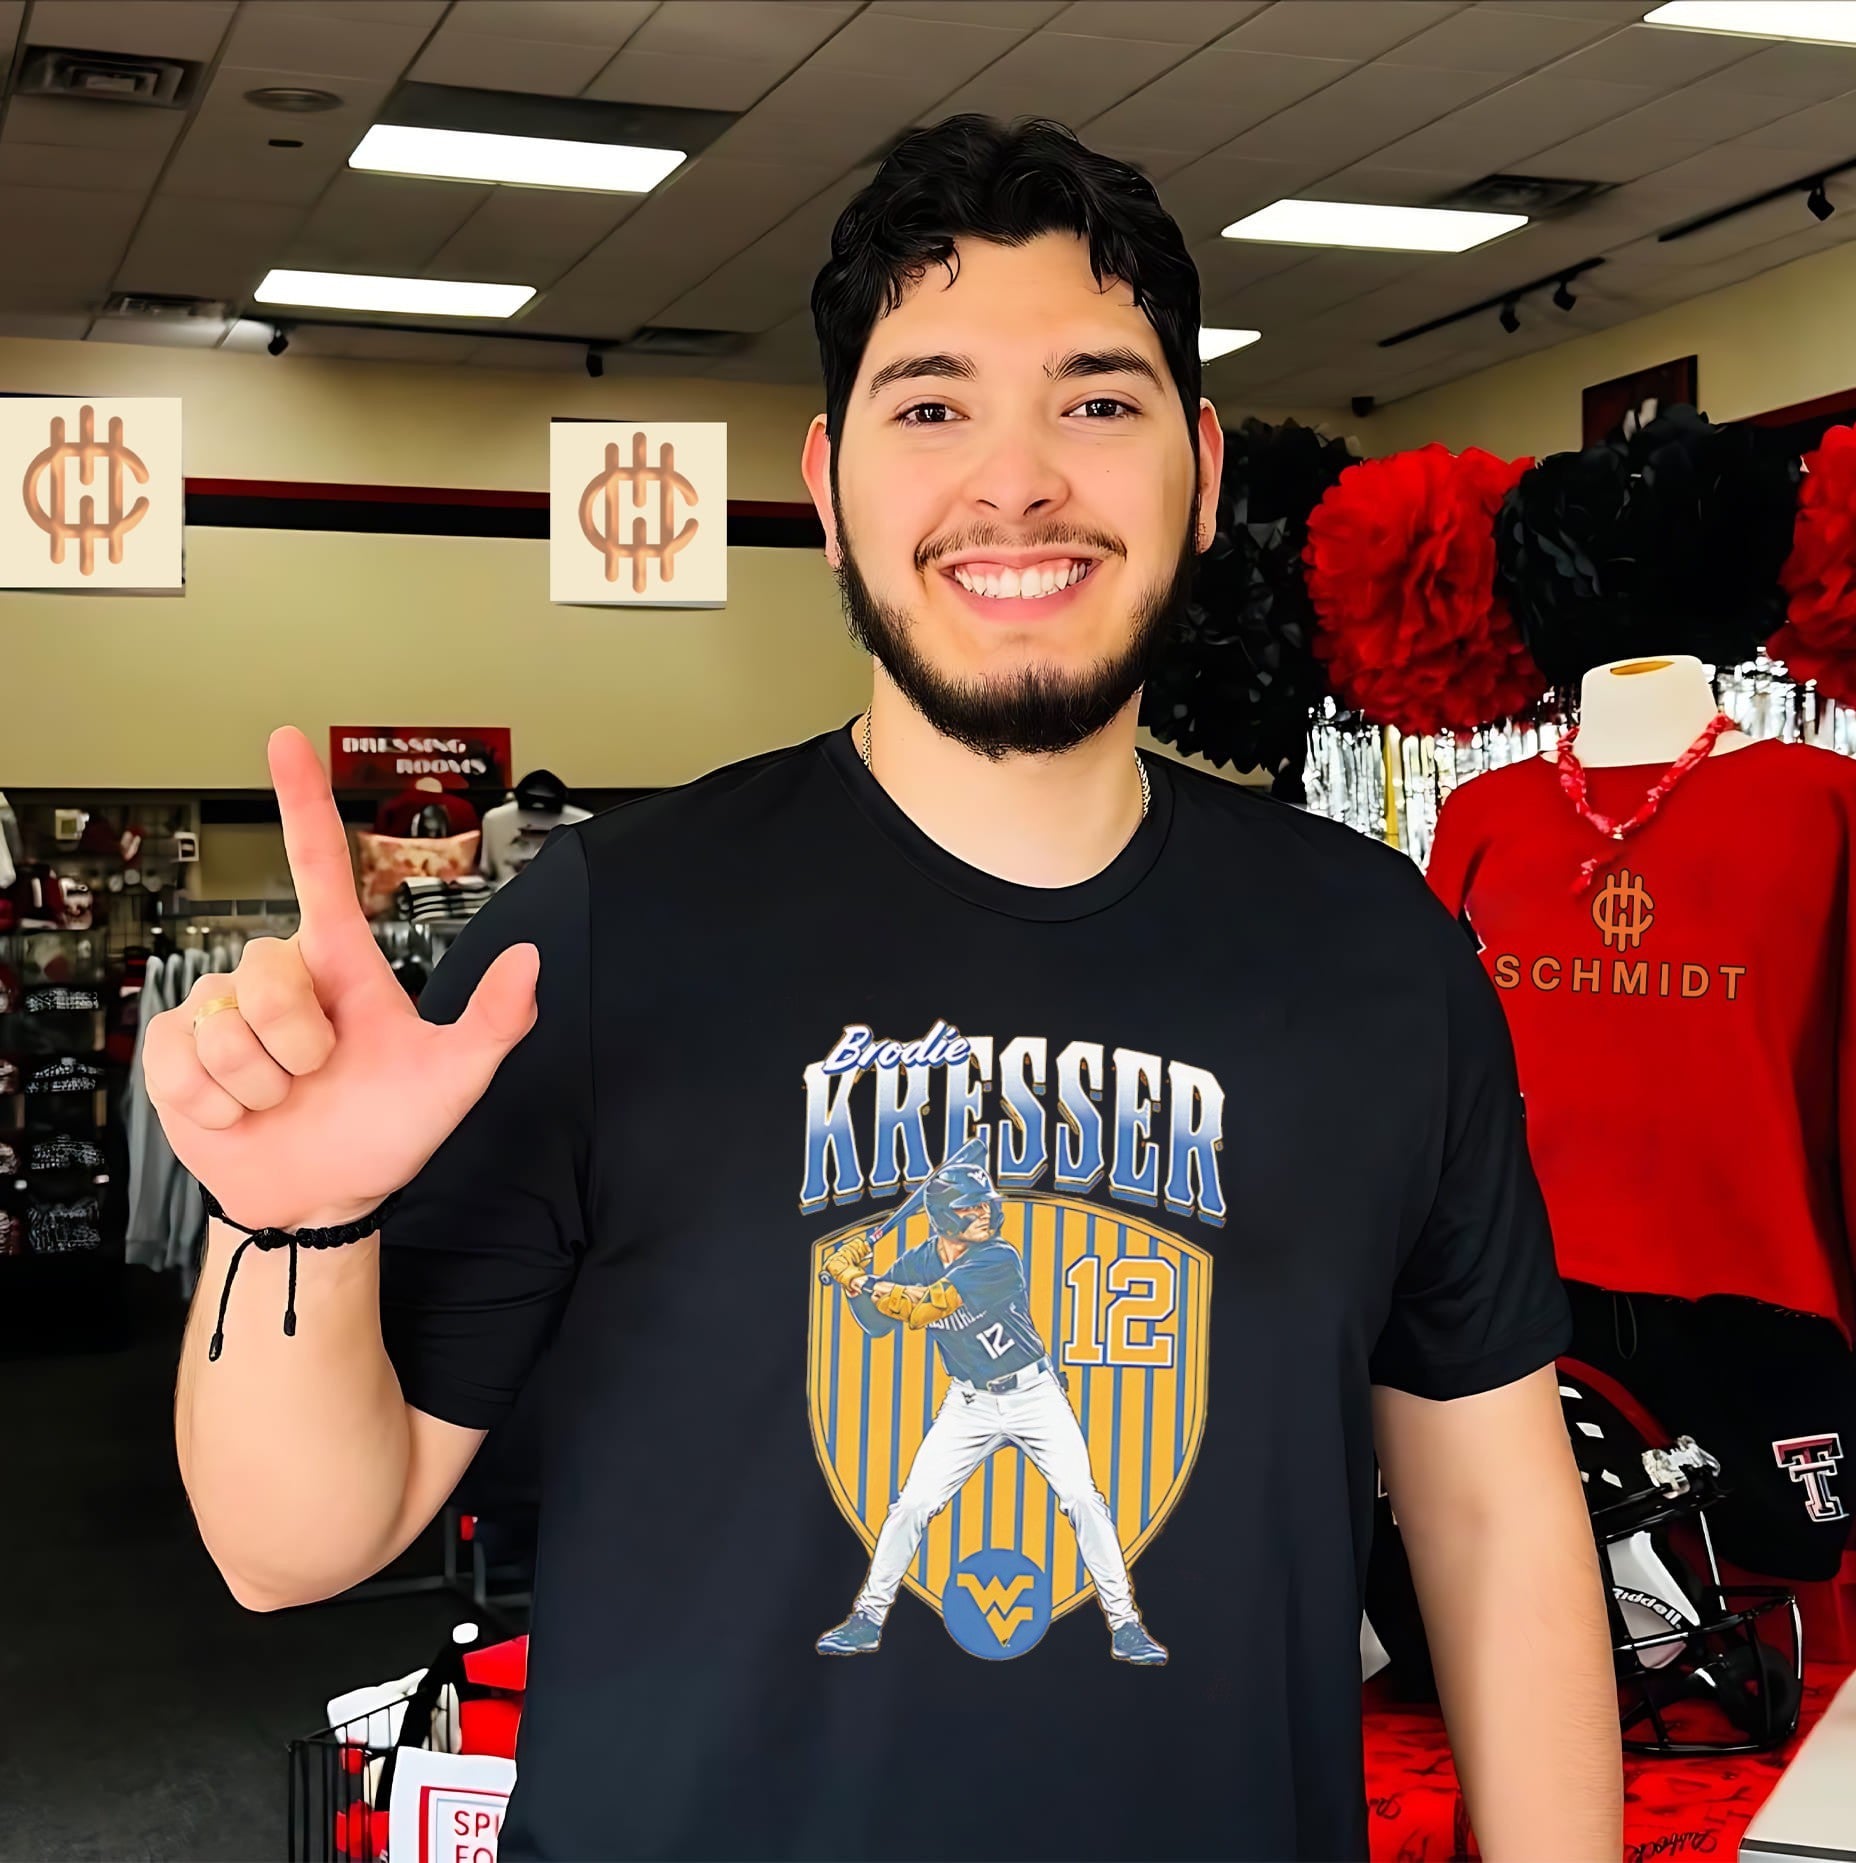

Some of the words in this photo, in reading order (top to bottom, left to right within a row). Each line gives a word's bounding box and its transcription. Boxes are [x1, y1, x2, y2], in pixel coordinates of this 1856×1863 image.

[342, 738, 466, 753] DRESSING
[396, 758, 487, 774] ROOMS
[1494, 953, 1747, 1001] SCHMIDT
[821, 1018, 972, 1076] Brodie
[799, 1034, 1227, 1229] KRESSER
[1063, 1254, 1177, 1368] 12
[975, 1321, 1016, 1360] 12
